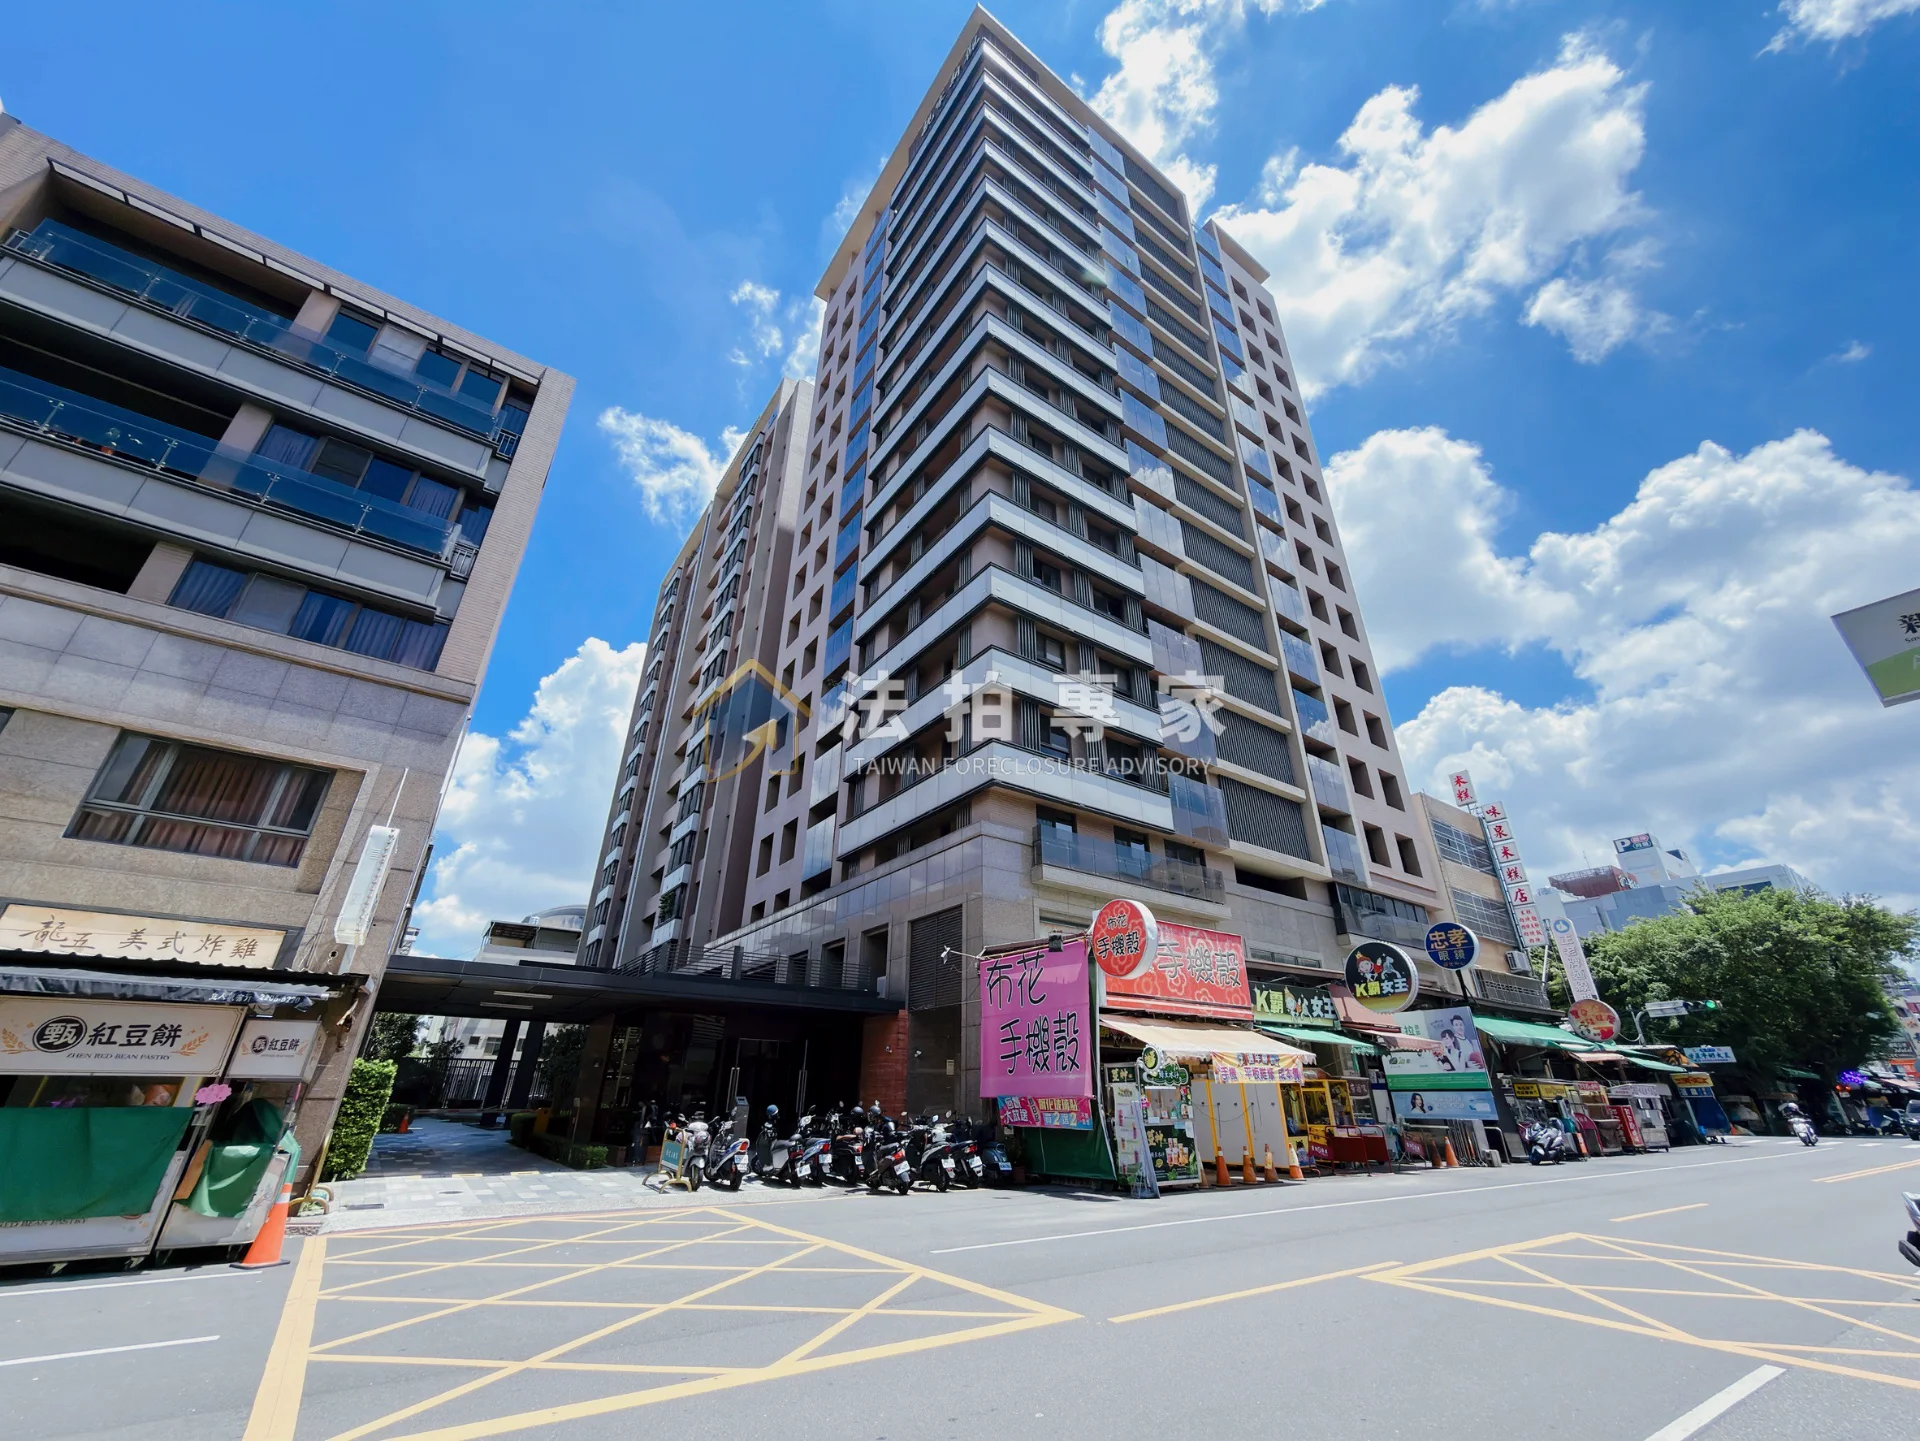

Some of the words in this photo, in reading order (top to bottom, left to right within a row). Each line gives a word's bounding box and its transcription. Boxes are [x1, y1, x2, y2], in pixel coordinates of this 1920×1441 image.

[1454, 775, 1473, 802] 米糕
[1485, 804, 1528, 903] 味泉米糕店
[1615, 839, 1630, 853] P
[1107, 914, 1128, 930] 布花
[19, 915, 96, 950] 龍五
[119, 928, 259, 959] 美式炸雞
[1097, 931, 1140, 959] 手機殼
[1429, 928, 1468, 949] 忠孝
[1157, 940, 1242, 988] 手機殼
[1438, 950, 1466, 961] 眼鏡
[986, 951, 1047, 1010] 布花
[1354, 977, 1409, 997] K霸女王
[1254, 988, 1284, 1014] K霸
[1311, 995, 1338, 1019] 女王
[86, 1022, 183, 1047] 紅豆餅
[268, 1038, 300, 1051] 紅豆餅
[1000, 1010, 1081, 1074] 手機殼
[94, 1052, 113, 1060] RED
[140, 1053, 172, 1061] PASTRY
